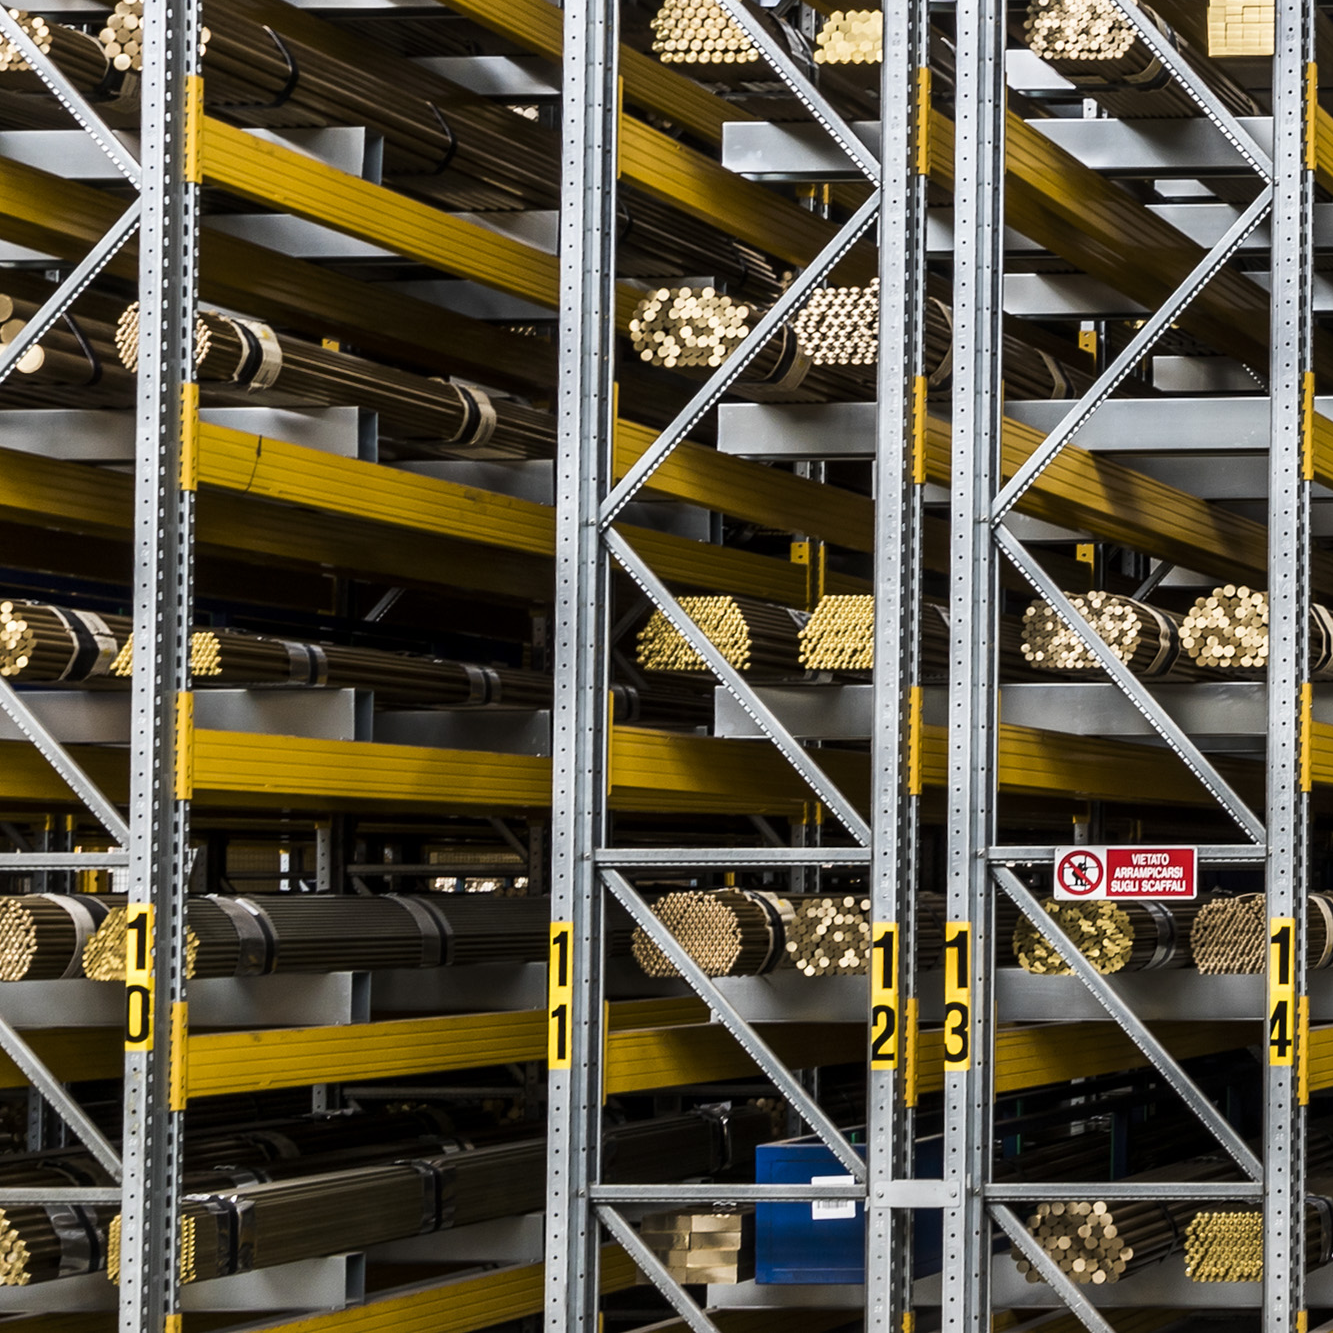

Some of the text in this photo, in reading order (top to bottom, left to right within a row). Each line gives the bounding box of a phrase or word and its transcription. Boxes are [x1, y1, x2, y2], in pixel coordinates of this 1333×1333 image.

[1131, 853, 1170, 865] VIETATO
[1113, 866, 1184, 879] ARRAMPICARSI
[1110, 879, 1186, 893] SUGLI SCAFFALI
